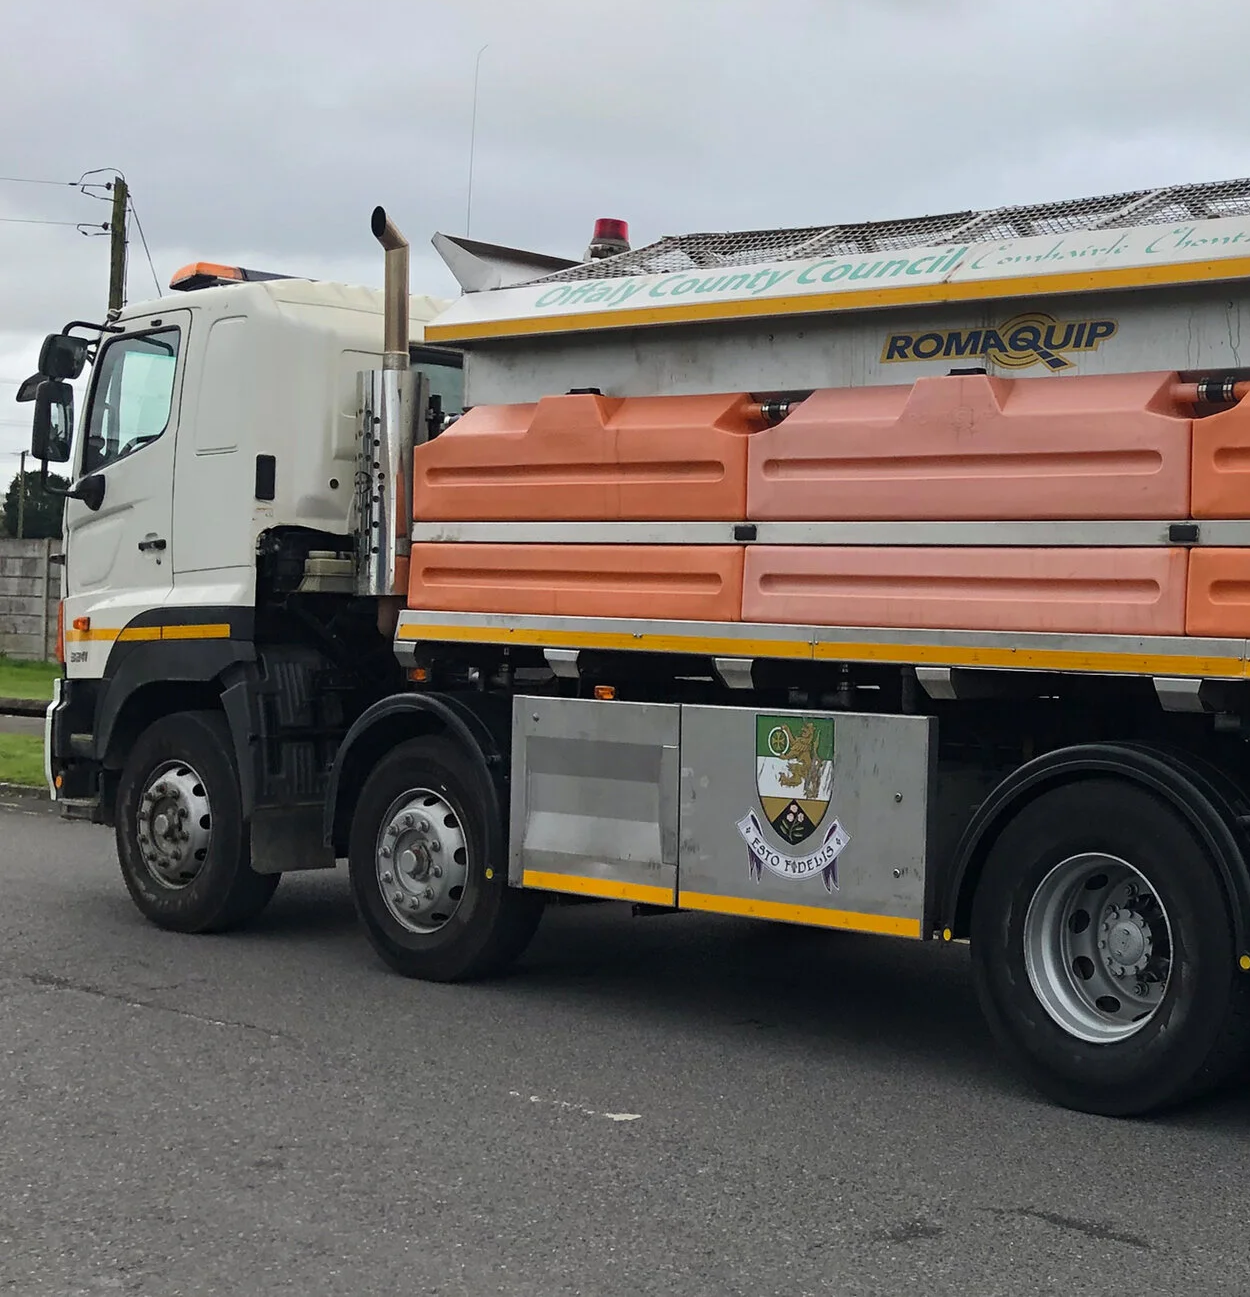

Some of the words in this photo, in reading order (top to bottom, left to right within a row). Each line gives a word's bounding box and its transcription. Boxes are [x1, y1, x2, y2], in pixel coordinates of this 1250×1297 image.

[534, 277, 649, 308] Offaly
[648, 266, 797, 296] County
[797, 246, 969, 285] Council
[885, 319, 1116, 370] ROMAQUIP
[751, 837, 780, 867] ESTO
